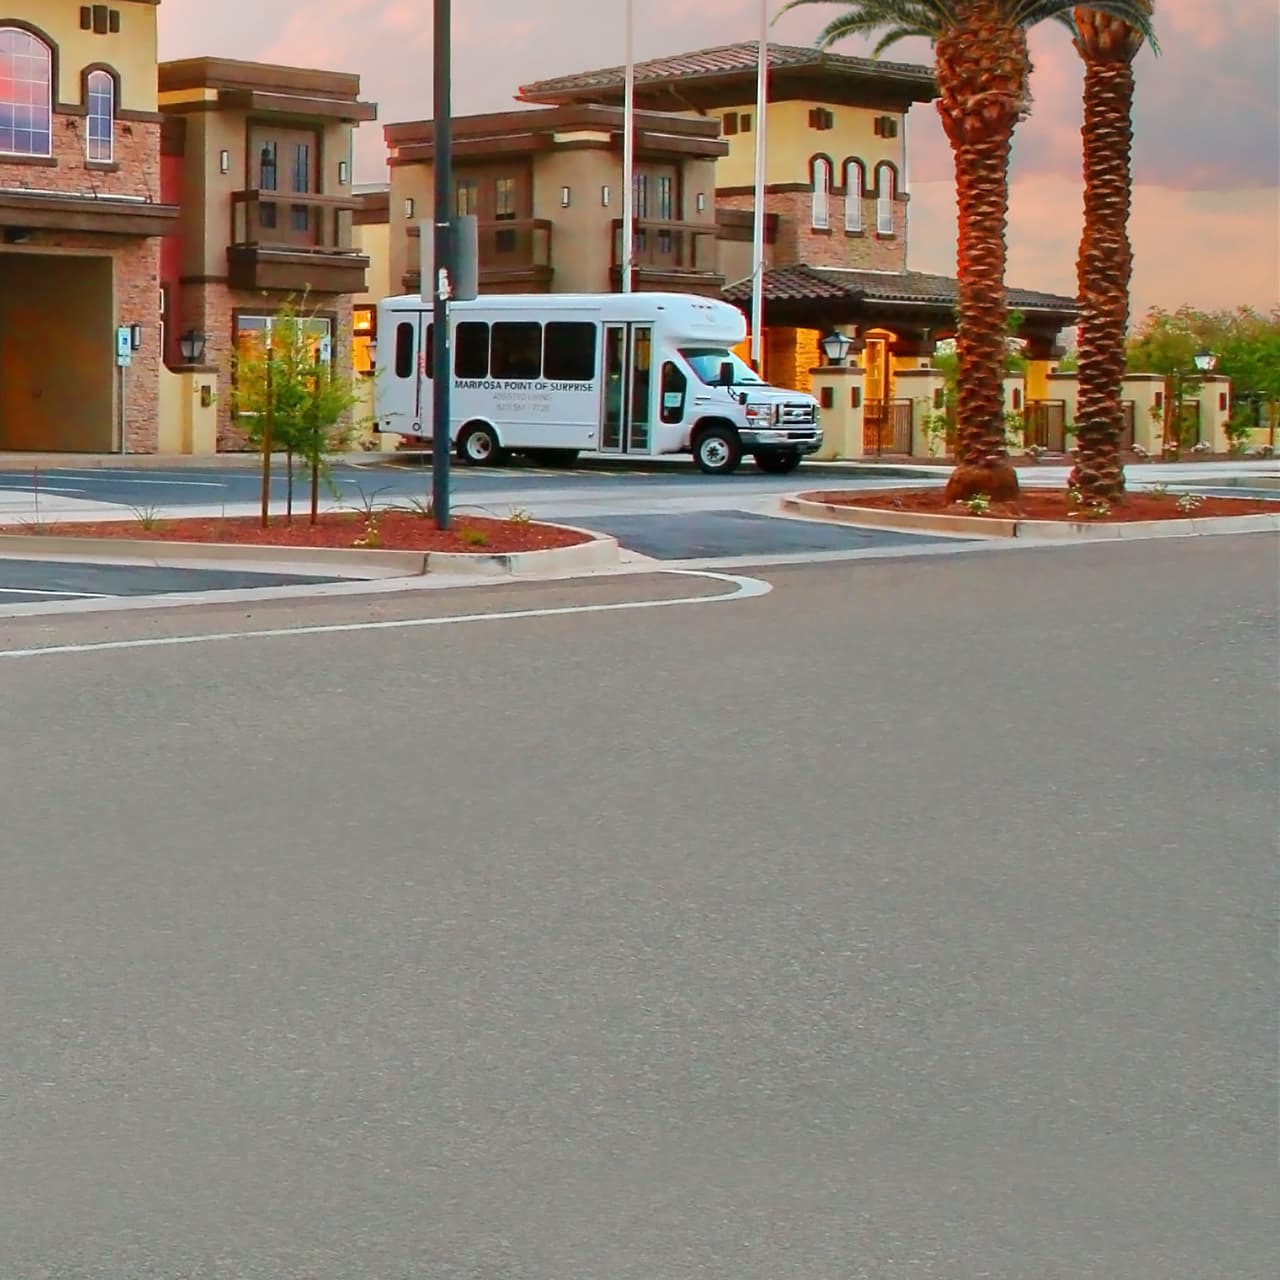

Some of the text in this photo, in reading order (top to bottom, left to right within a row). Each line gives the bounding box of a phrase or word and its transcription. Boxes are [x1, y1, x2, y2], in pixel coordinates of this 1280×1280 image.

[454, 380, 593, 392] MARIPOSA POINT OF SURPRISE
